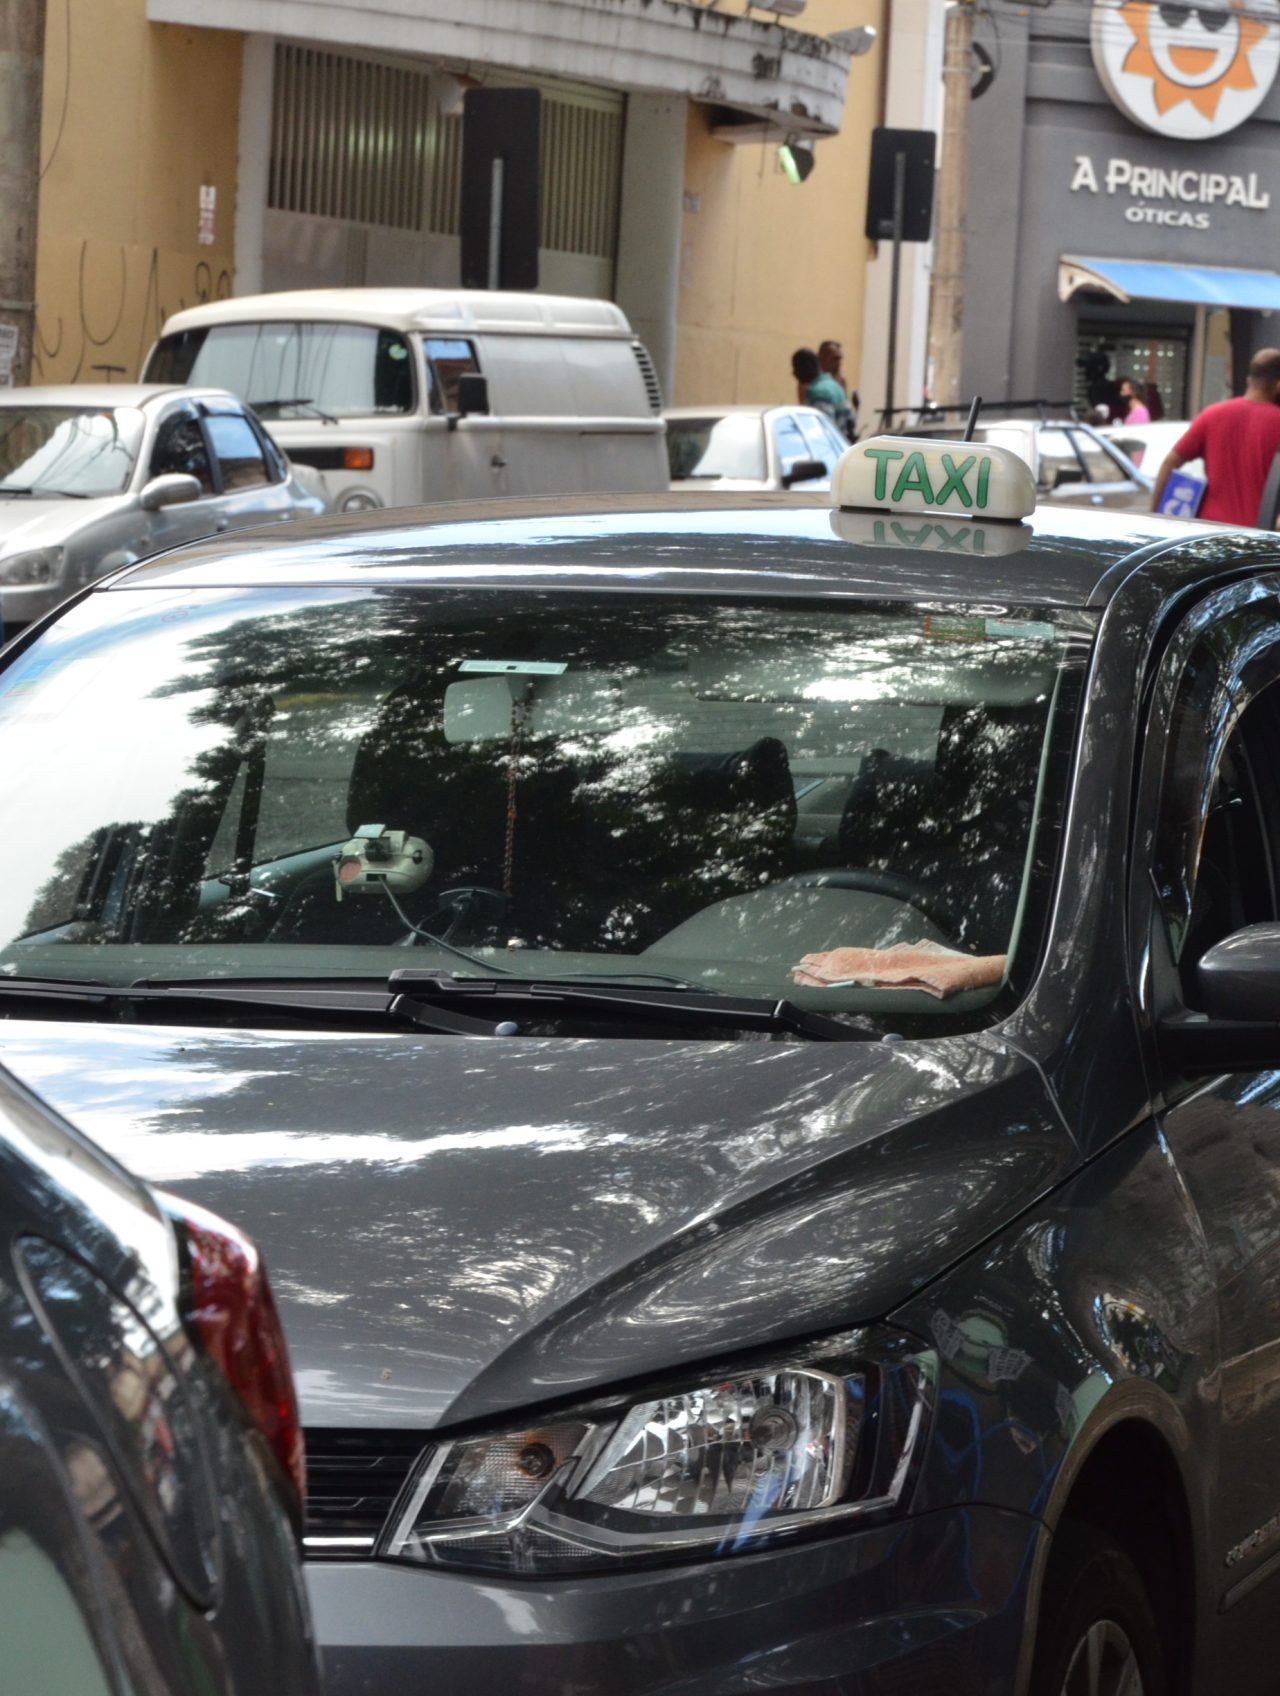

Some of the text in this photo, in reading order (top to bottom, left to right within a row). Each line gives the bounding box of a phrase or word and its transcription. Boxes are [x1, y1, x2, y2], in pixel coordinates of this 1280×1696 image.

[1070, 155, 1271, 209] A PRINCIPAL
[1124, 201, 1211, 229] ÓTICAS
[863, 448, 991, 509] TAXI
